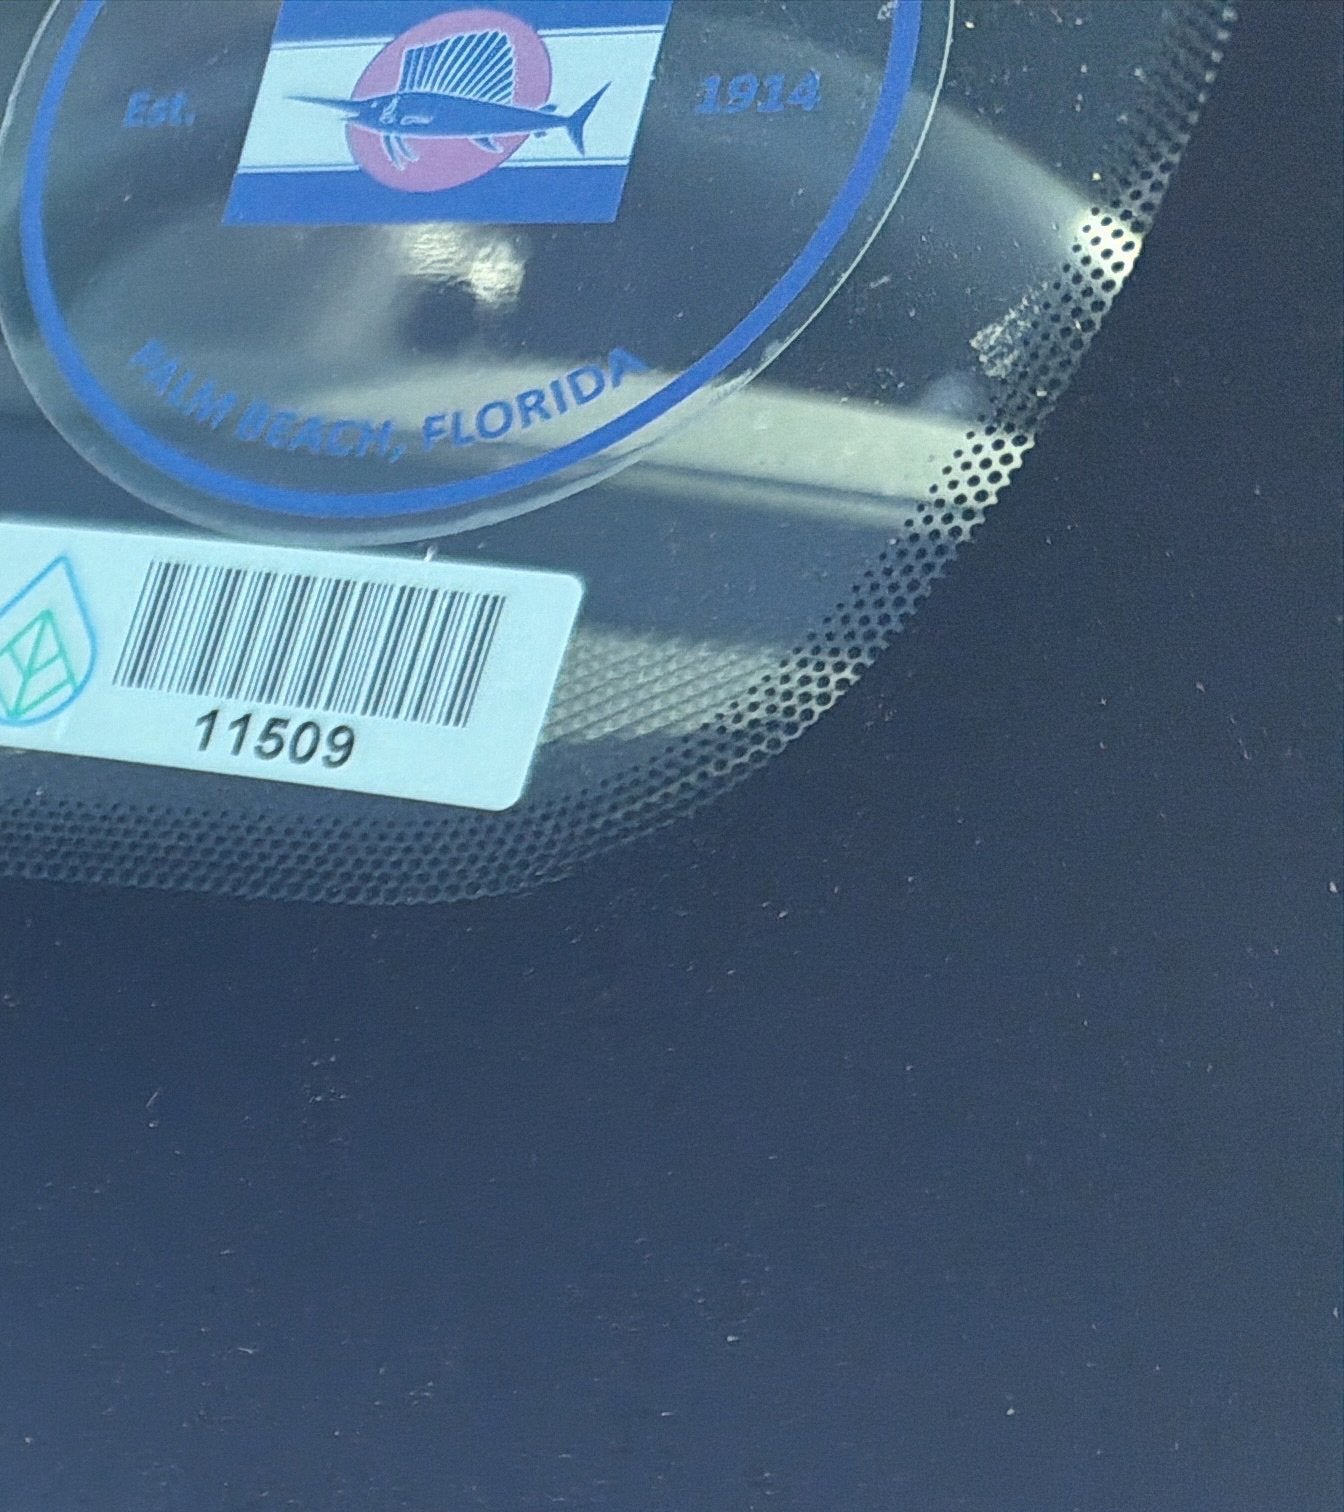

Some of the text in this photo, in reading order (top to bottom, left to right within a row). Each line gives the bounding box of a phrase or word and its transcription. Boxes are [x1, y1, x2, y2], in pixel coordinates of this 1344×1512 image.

[693, 69, 822, 113] 1914
[127, 339, 238, 430] PALM
[421, 346, 650, 451] FLORIDA
[195, 708, 356, 769] 11509
